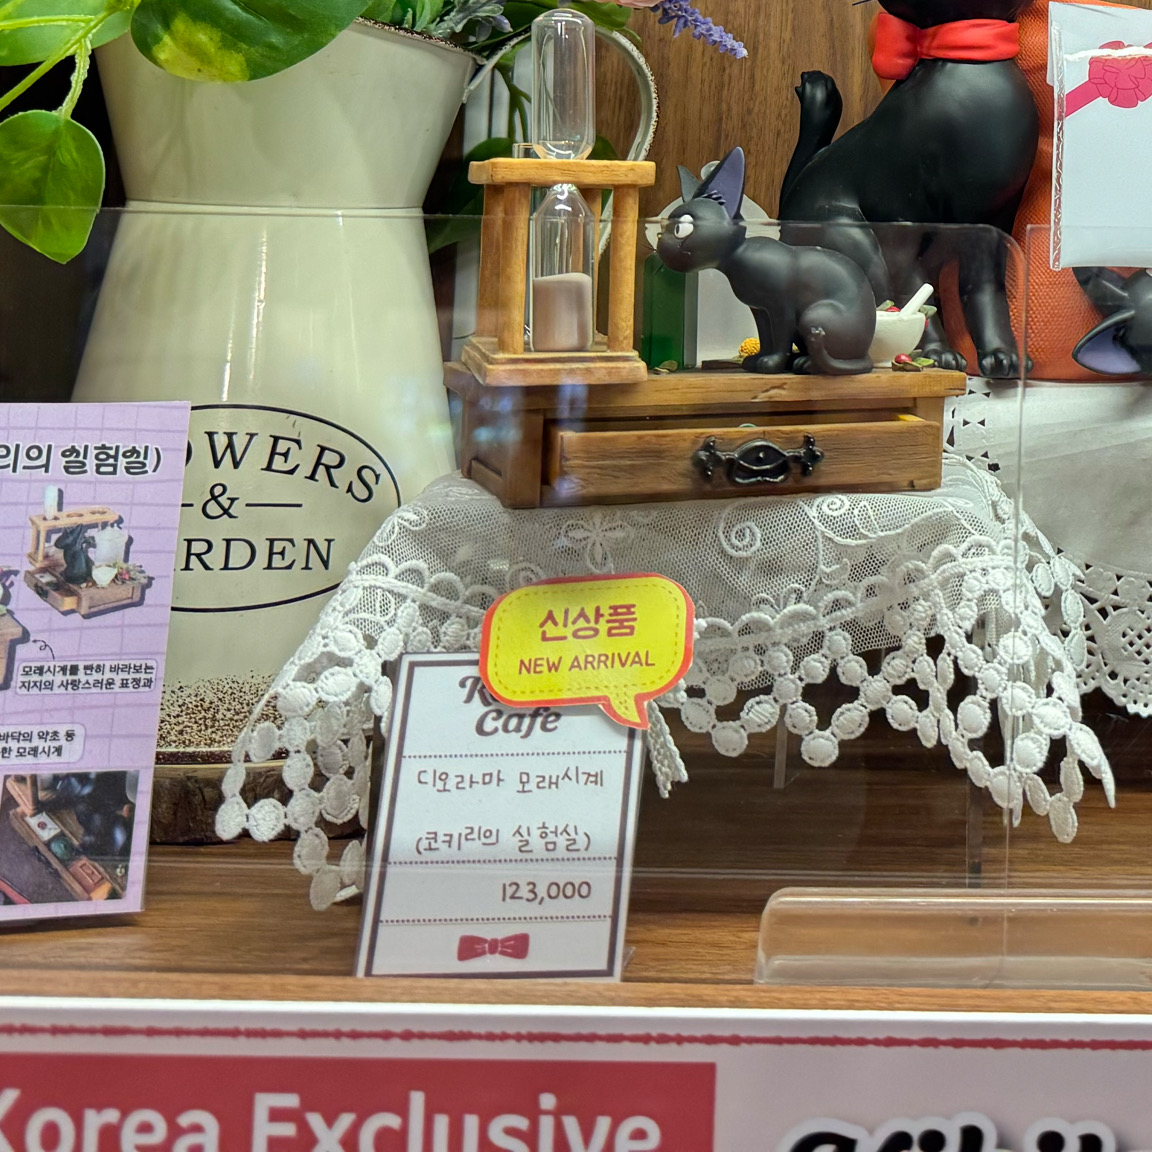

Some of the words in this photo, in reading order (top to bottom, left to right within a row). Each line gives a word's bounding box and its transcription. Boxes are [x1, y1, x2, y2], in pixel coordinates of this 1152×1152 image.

[60, 443, 162, 475] 실험실)
[201, 482, 240, 520] &
[176, 537, 335, 571] RDEN
[538, 604, 638, 642] 신상품
[109, 662, 154, 675] 바라보는
[518, 656, 562, 675] NEW
[568, 650, 656, 672] ARRIVAL
[19, 679, 54, 692] 지지의
[57, 678, 116, 691] 사랑스러운
[118, 677, 153, 690] 표정과
[64, 729, 76, 742] 등
[475, 707, 562, 739] Cafe
[417, 769, 505, 793] 디오라마
[516, 766, 604, 793] 모래시계
[415, 825, 499, 855] (코키리의
[512, 822, 591, 854] 실험실)
[501, 880, 592, 905] 123,000
[253, 1090, 662, 1152] Exclusive
